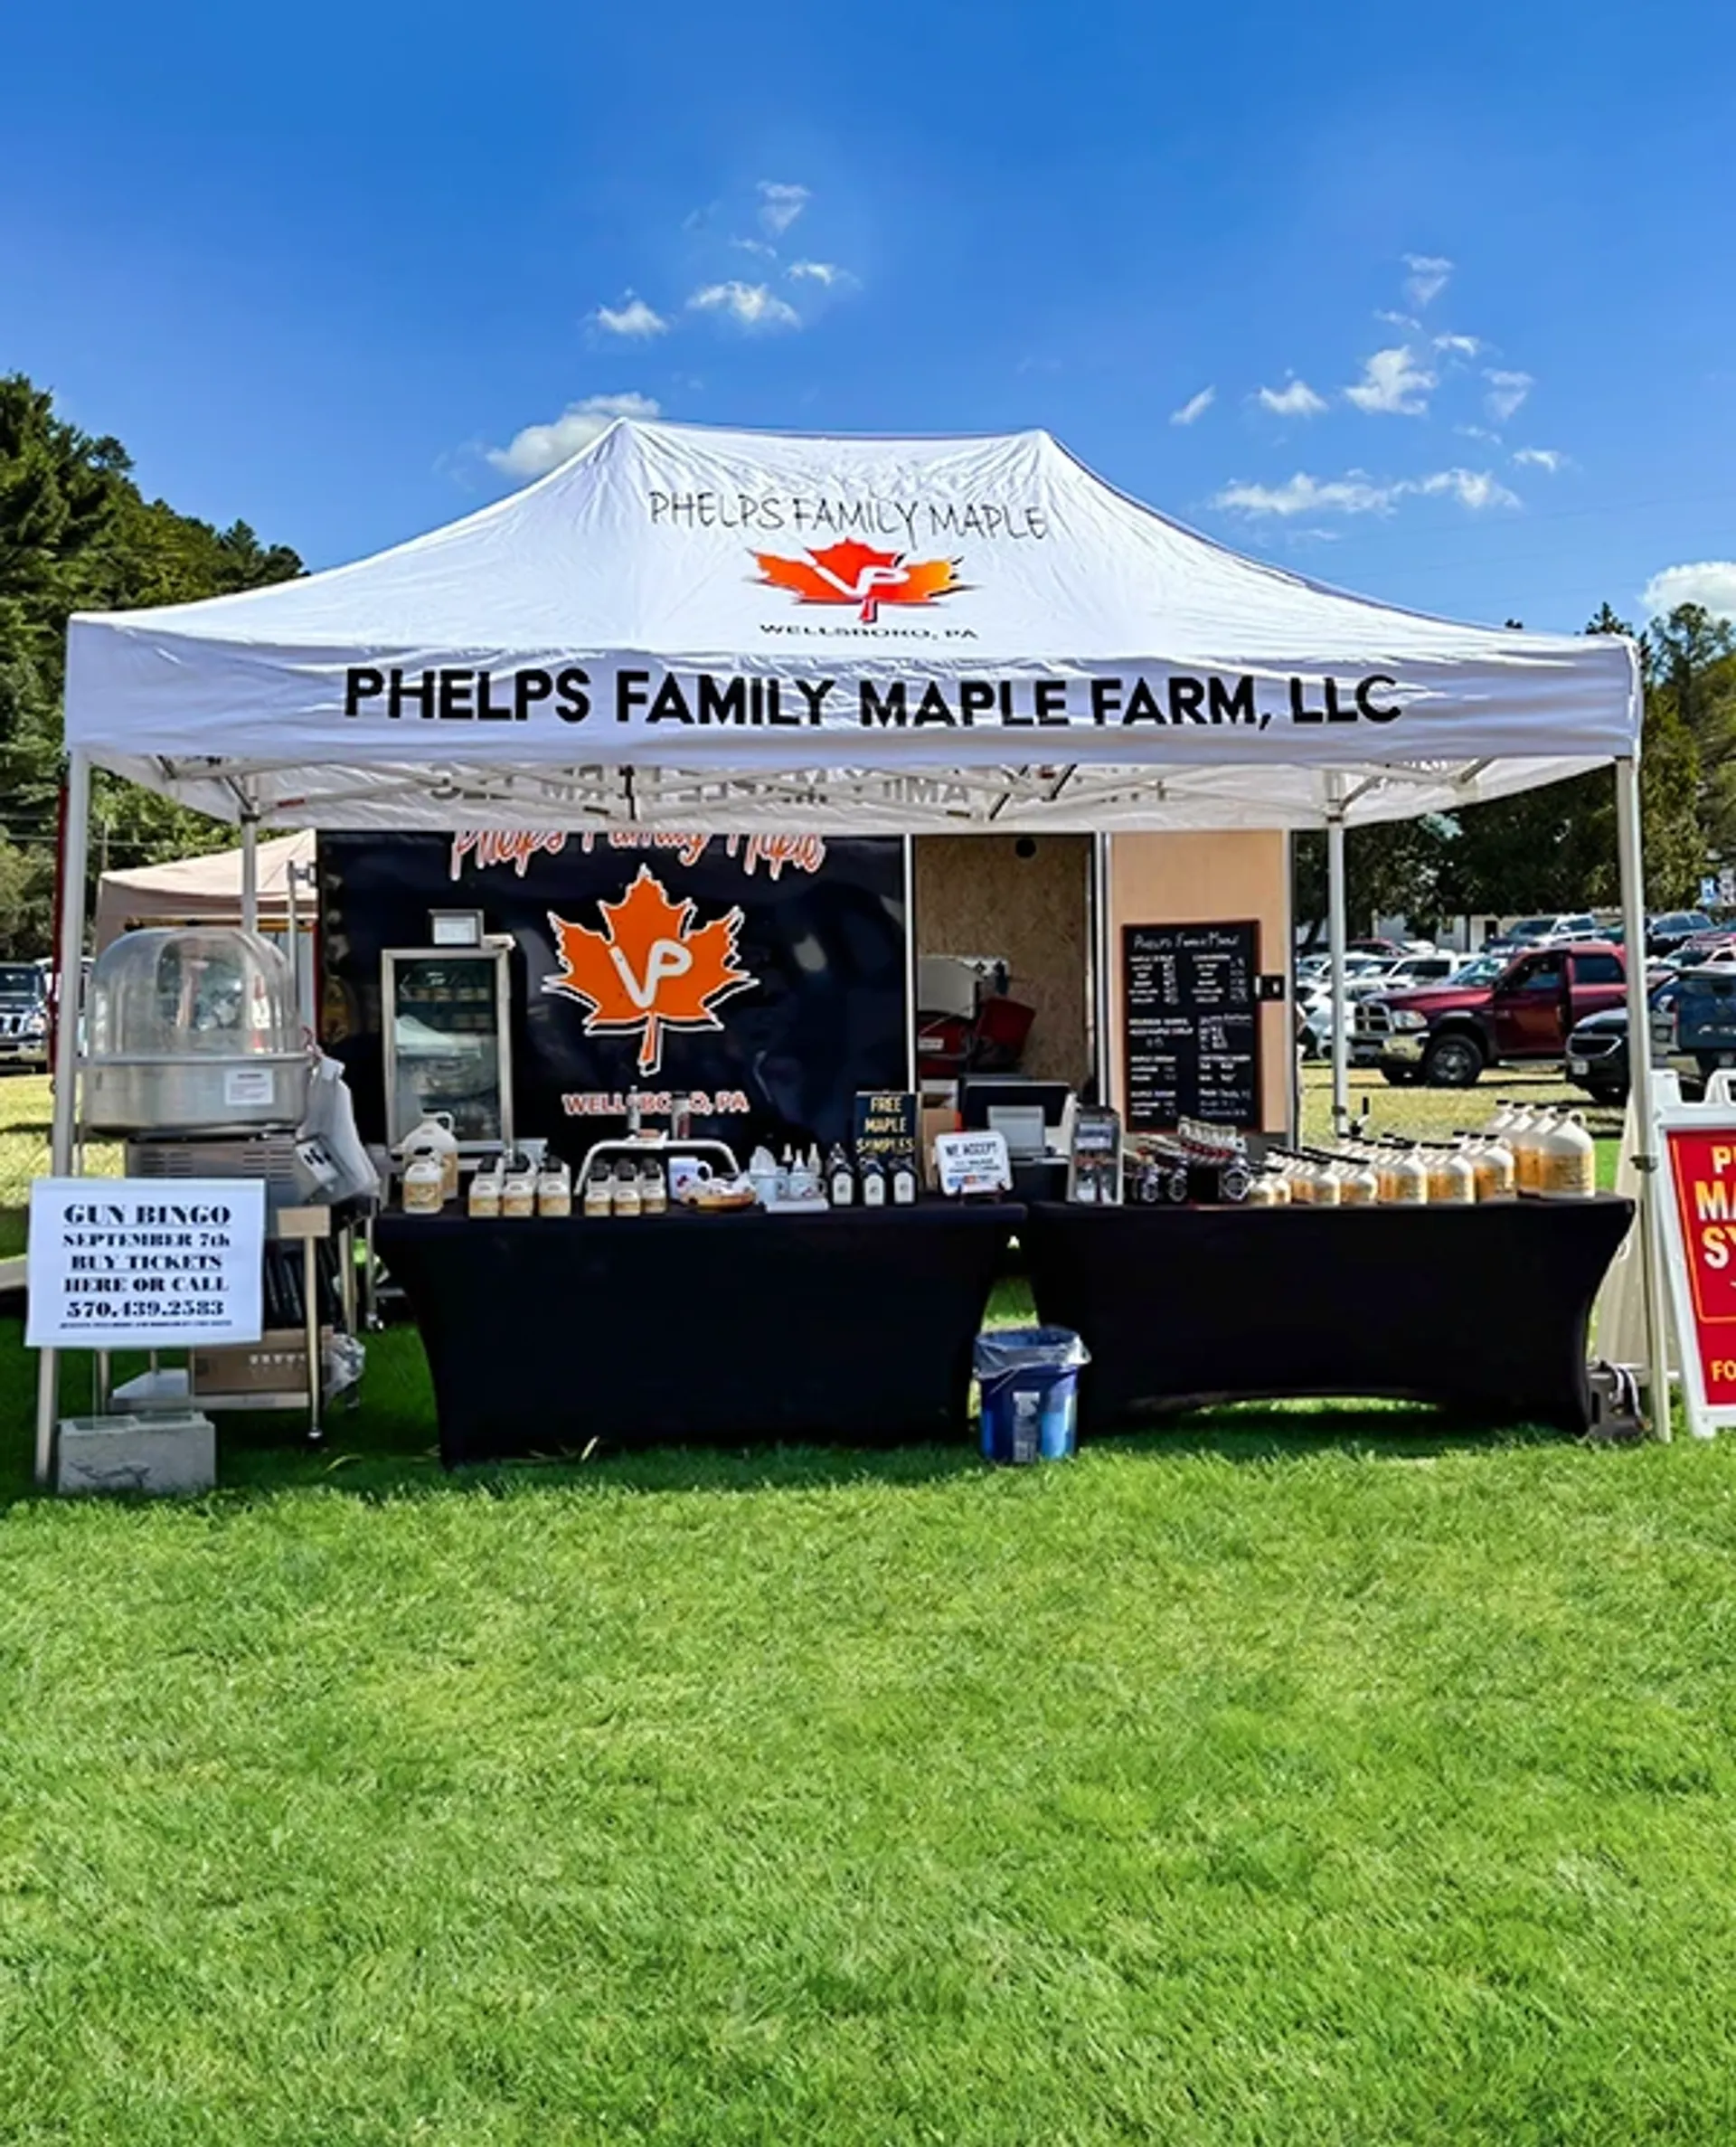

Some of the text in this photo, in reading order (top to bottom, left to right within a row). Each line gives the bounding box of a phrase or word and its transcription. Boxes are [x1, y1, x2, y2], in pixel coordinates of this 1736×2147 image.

[649, 491, 1048, 550] PHELPS FAMILY MAPLE
[344, 667, 1403, 731] PHELPS FAMILY MAPLE FARM, LLC
[561, 1091, 750, 1115] WELLBOO, PA
[871, 1096, 902, 1112] FREE
[864, 1116, 907, 1133] MAPLE
[63, 1204, 231, 1225] GUN BINGO
[62, 1233, 230, 1247] SEPTEMBER 7th
[71, 1254, 222, 1269] BUY TICKETS
[64, 1276, 230, 1292] HERE OR CALL
